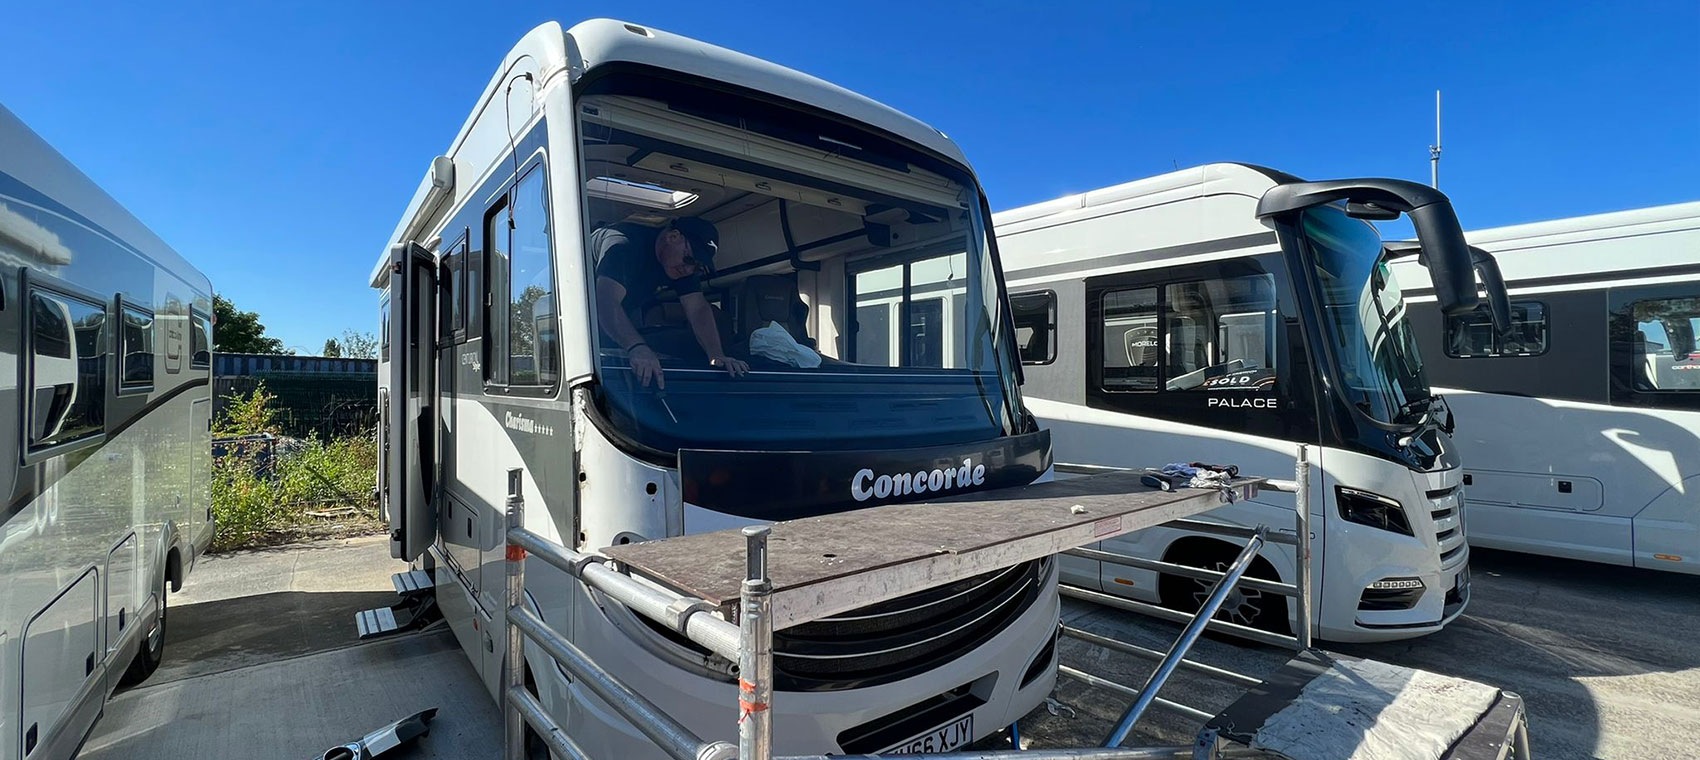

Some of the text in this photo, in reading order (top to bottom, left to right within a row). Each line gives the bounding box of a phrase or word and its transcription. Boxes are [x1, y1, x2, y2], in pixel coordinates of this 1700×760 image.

[1208, 376, 1250, 386] SOLD
[1208, 398, 1277, 408] PALACE
[505, 411, 534, 434] Charisma
[851, 458, 986, 502] Concorde
[939, 719, 969, 753] XJY
